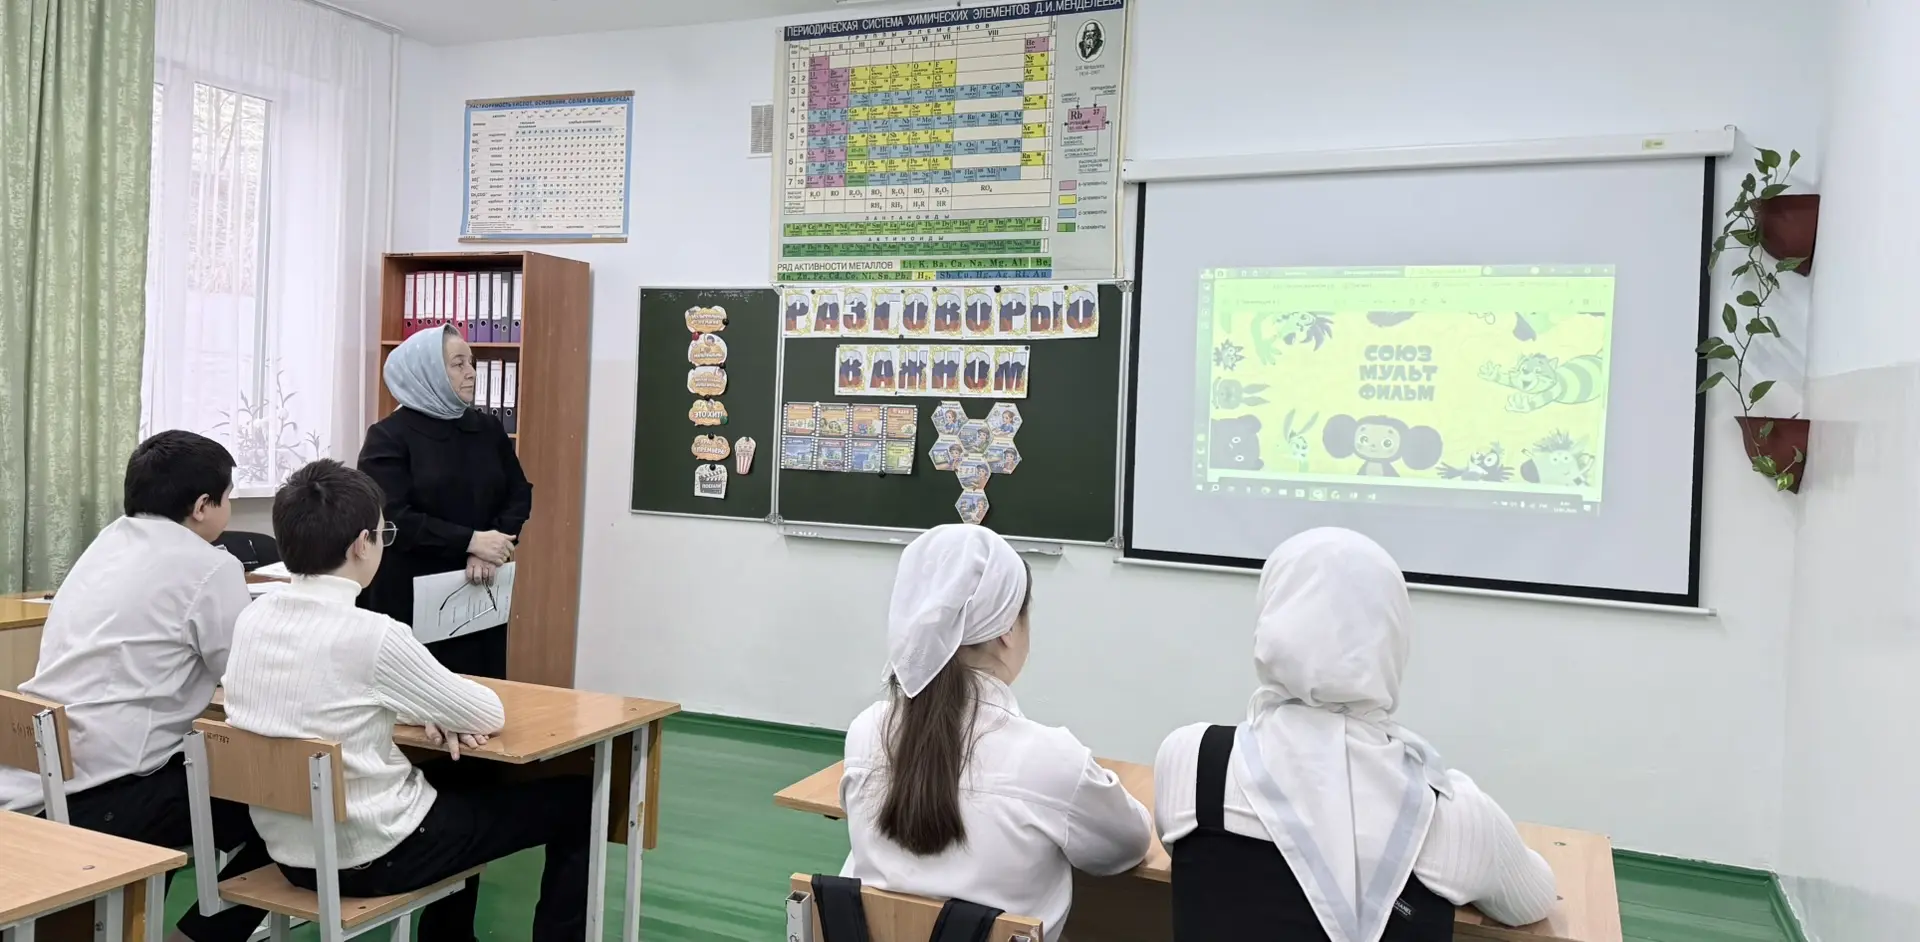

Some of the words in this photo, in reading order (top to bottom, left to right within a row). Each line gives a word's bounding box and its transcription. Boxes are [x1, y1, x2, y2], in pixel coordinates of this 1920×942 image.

[787, 21, 858, 37] ПЕРИОДИЧЕСКАЯ
[862, 16, 904, 30] СИСТЕМА
[907, 11, 968, 26] ХИМИЧЕСКИХ
[973, 4, 1030, 19] ЭЛЕМЕНТОВ
[1071, 110, 1082, 120] Rb
[778, 263, 793, 272] РЯД
[794, 262, 848, 271] АКТИВНОСТИ
[849, 261, 893, 270] МЕТАЛЛОВ
[785, 291, 1063, 332] РАЗГОВОРЫ
[1066, 291, 1096, 332] О
[1364, 344, 1432, 362] СОЮЗ
[839, 350, 1028, 391] ВАЖНОМ
[1360, 365, 1438, 382] МУЛЬТ
[1358, 384, 1435, 401] ФИЛЬМ
